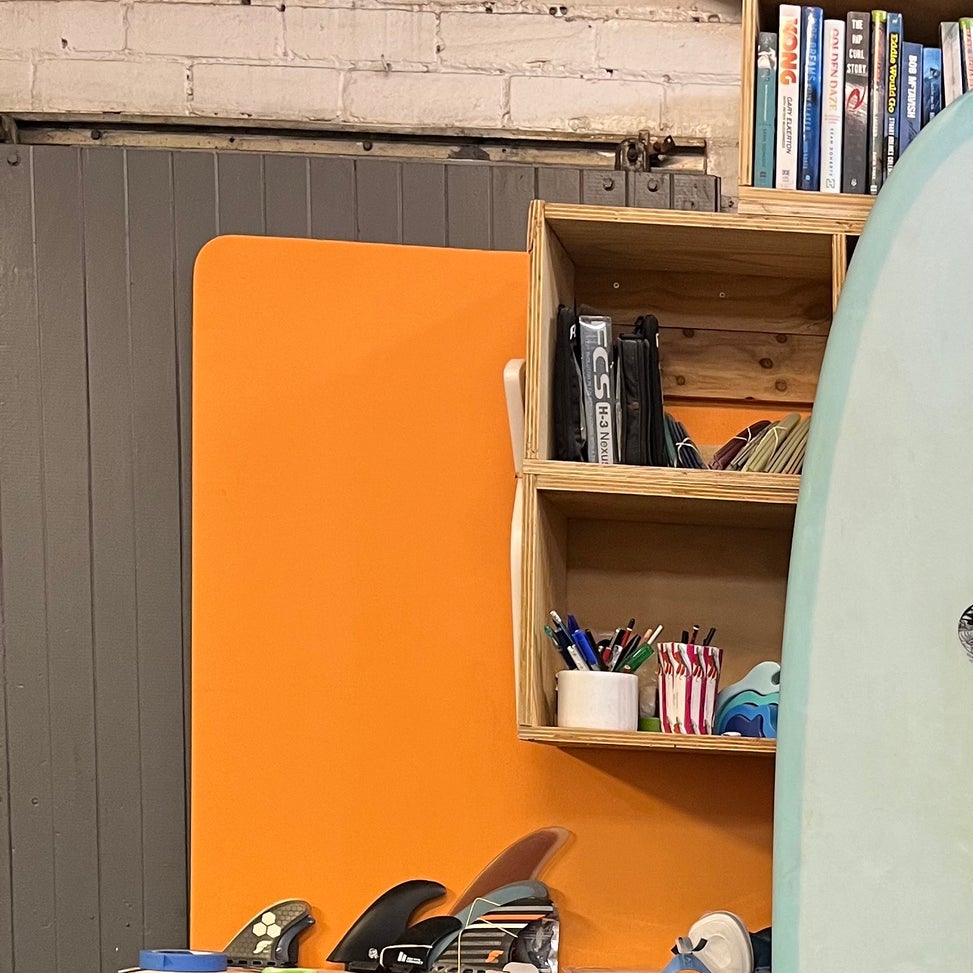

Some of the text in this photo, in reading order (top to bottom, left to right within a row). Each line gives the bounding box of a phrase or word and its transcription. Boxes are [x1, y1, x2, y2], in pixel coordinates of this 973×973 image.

[851, 18, 864, 31] THE
[779, 18, 798, 86] KONG
[852, 34, 863, 46] RIP
[849, 48, 865, 60] CURL
[909, 54, 919, 75] BOB
[846, 63, 867, 75] STORY
[887, 33, 899, 114] Eddie Would Go
[828, 80, 839, 112] DAZE
[785, 117, 793, 155] ELKERTON
[591, 321, 610, 429] FCS H-3
